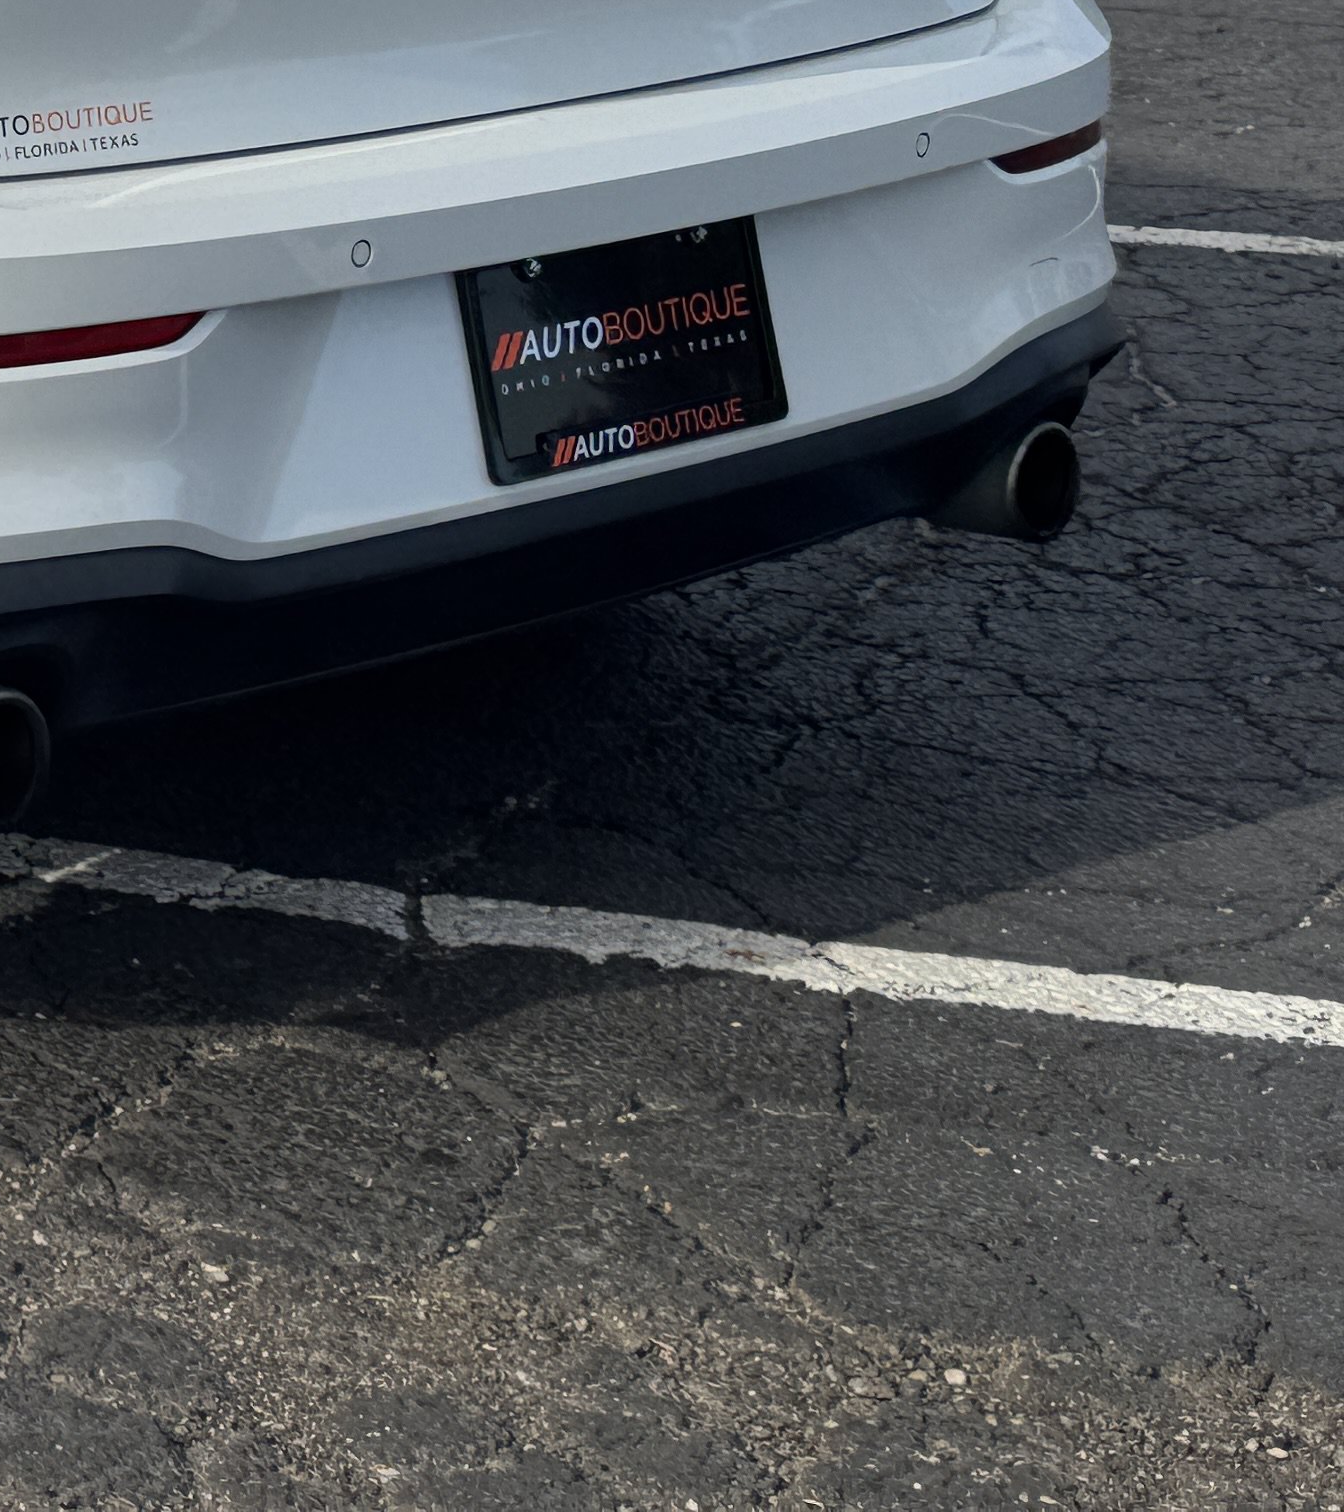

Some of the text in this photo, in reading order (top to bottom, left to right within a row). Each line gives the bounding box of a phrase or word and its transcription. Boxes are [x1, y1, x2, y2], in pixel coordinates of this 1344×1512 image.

[14, 140, 80, 160] FLORIDA
[89, 133, 140, 151] TEXAS
[519, 283, 751, 365] AUTOBOUTIQUE
[573, 397, 746, 462] AUTOBOUTIQUE
